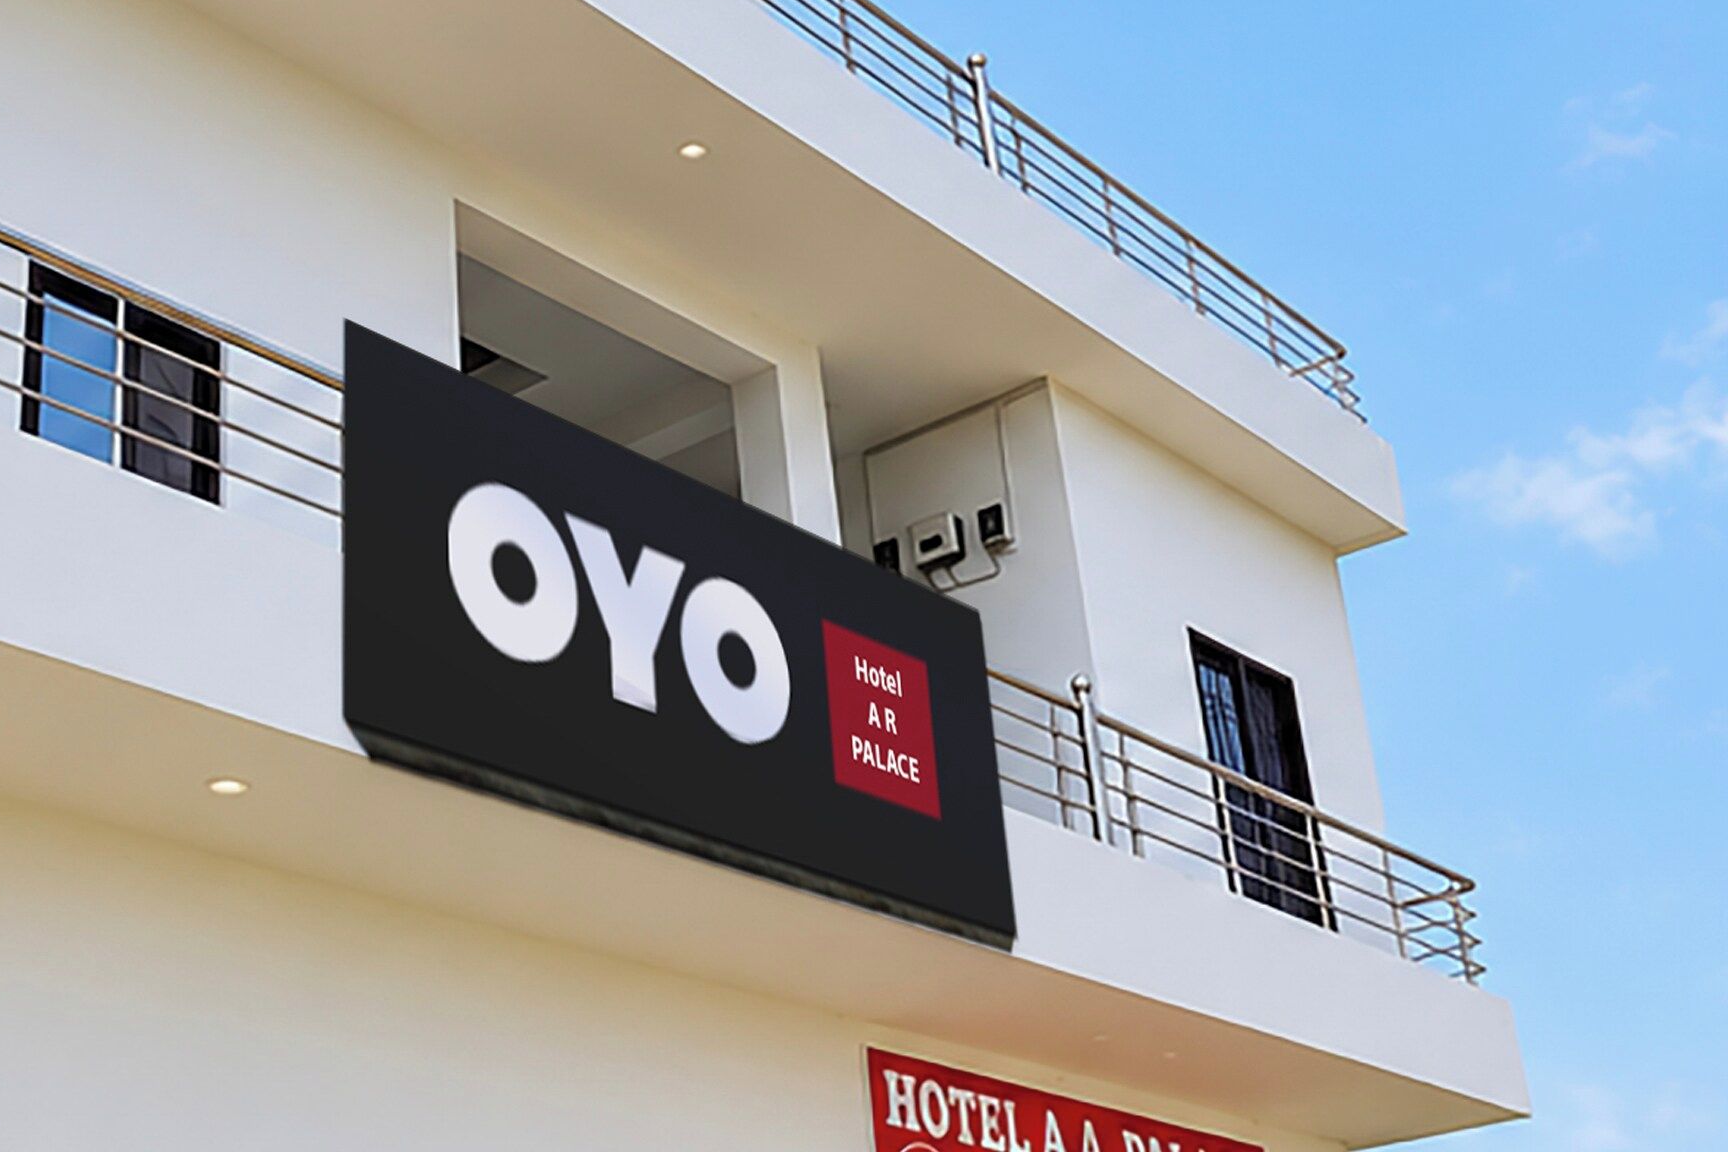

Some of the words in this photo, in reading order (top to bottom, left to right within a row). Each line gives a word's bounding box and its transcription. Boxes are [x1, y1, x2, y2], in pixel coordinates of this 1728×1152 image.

[447, 482, 791, 745] OYO
[854, 655, 903, 698] Hotel
[868, 701, 882, 729] A
[884, 707, 898, 735] R
[851, 734, 921, 784] PALACE
[883, 1069, 1031, 1152] HOTEL
